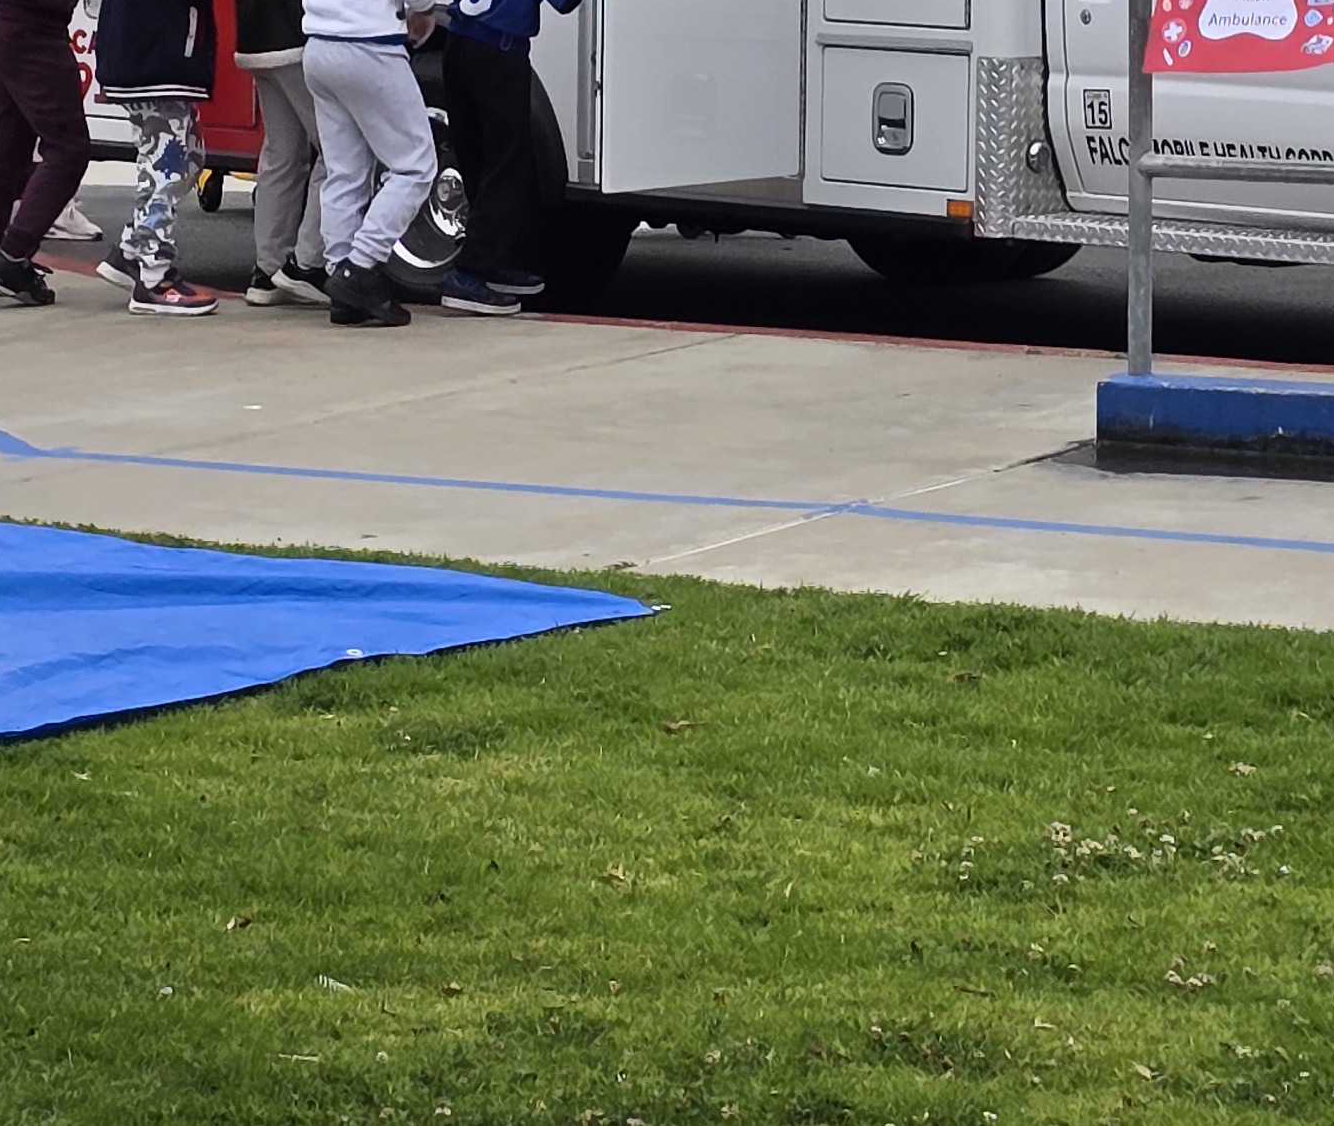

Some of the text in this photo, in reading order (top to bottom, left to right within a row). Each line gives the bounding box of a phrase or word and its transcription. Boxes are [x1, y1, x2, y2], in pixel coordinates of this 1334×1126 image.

[1208, 12, 1287, 27] Ambulance
[1087, 100, 1108, 125] 15
[1086, 135, 1130, 166] FALC
